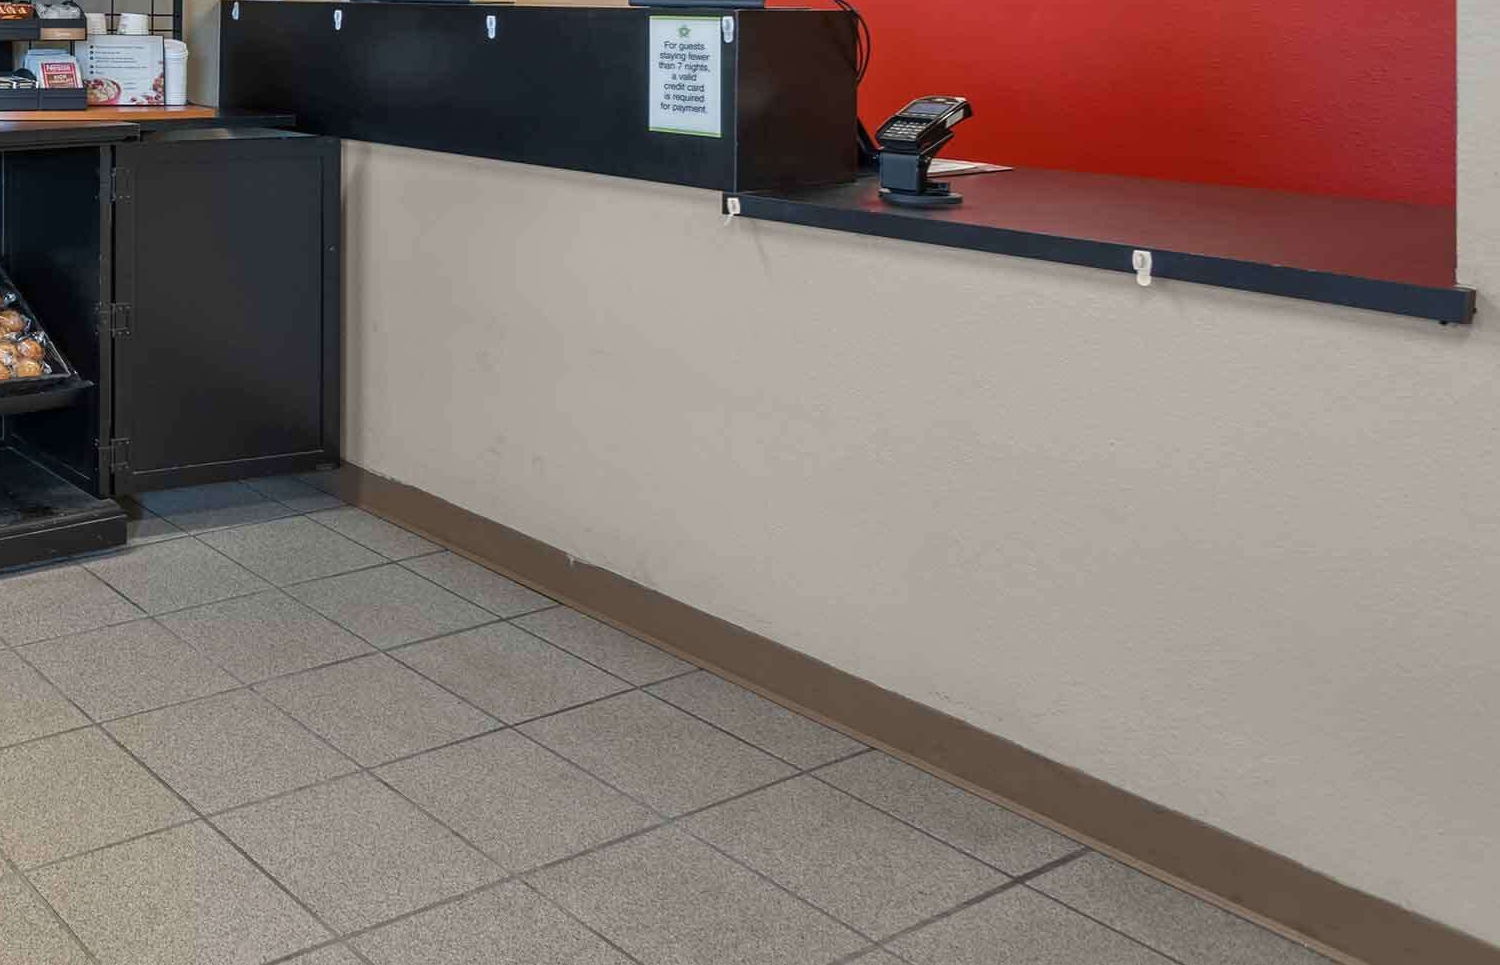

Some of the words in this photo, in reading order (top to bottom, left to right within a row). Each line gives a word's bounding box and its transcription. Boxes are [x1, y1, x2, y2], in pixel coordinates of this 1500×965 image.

[664, 40, 677, 49] For
[679, 43, 705, 51] guests
[660, 52, 686, 61] staying
[688, 52, 710, 61] fewer
[677, 62, 682, 70] 7
[684, 63, 711, 73] nights,
[678, 73, 697, 81] valid
[664, 82, 685, 90] credit
[687, 84, 704, 92] card
[673, 93, 704, 103] required
[660, 102, 670, 110] for
[672, 104, 708, 113] payment.
